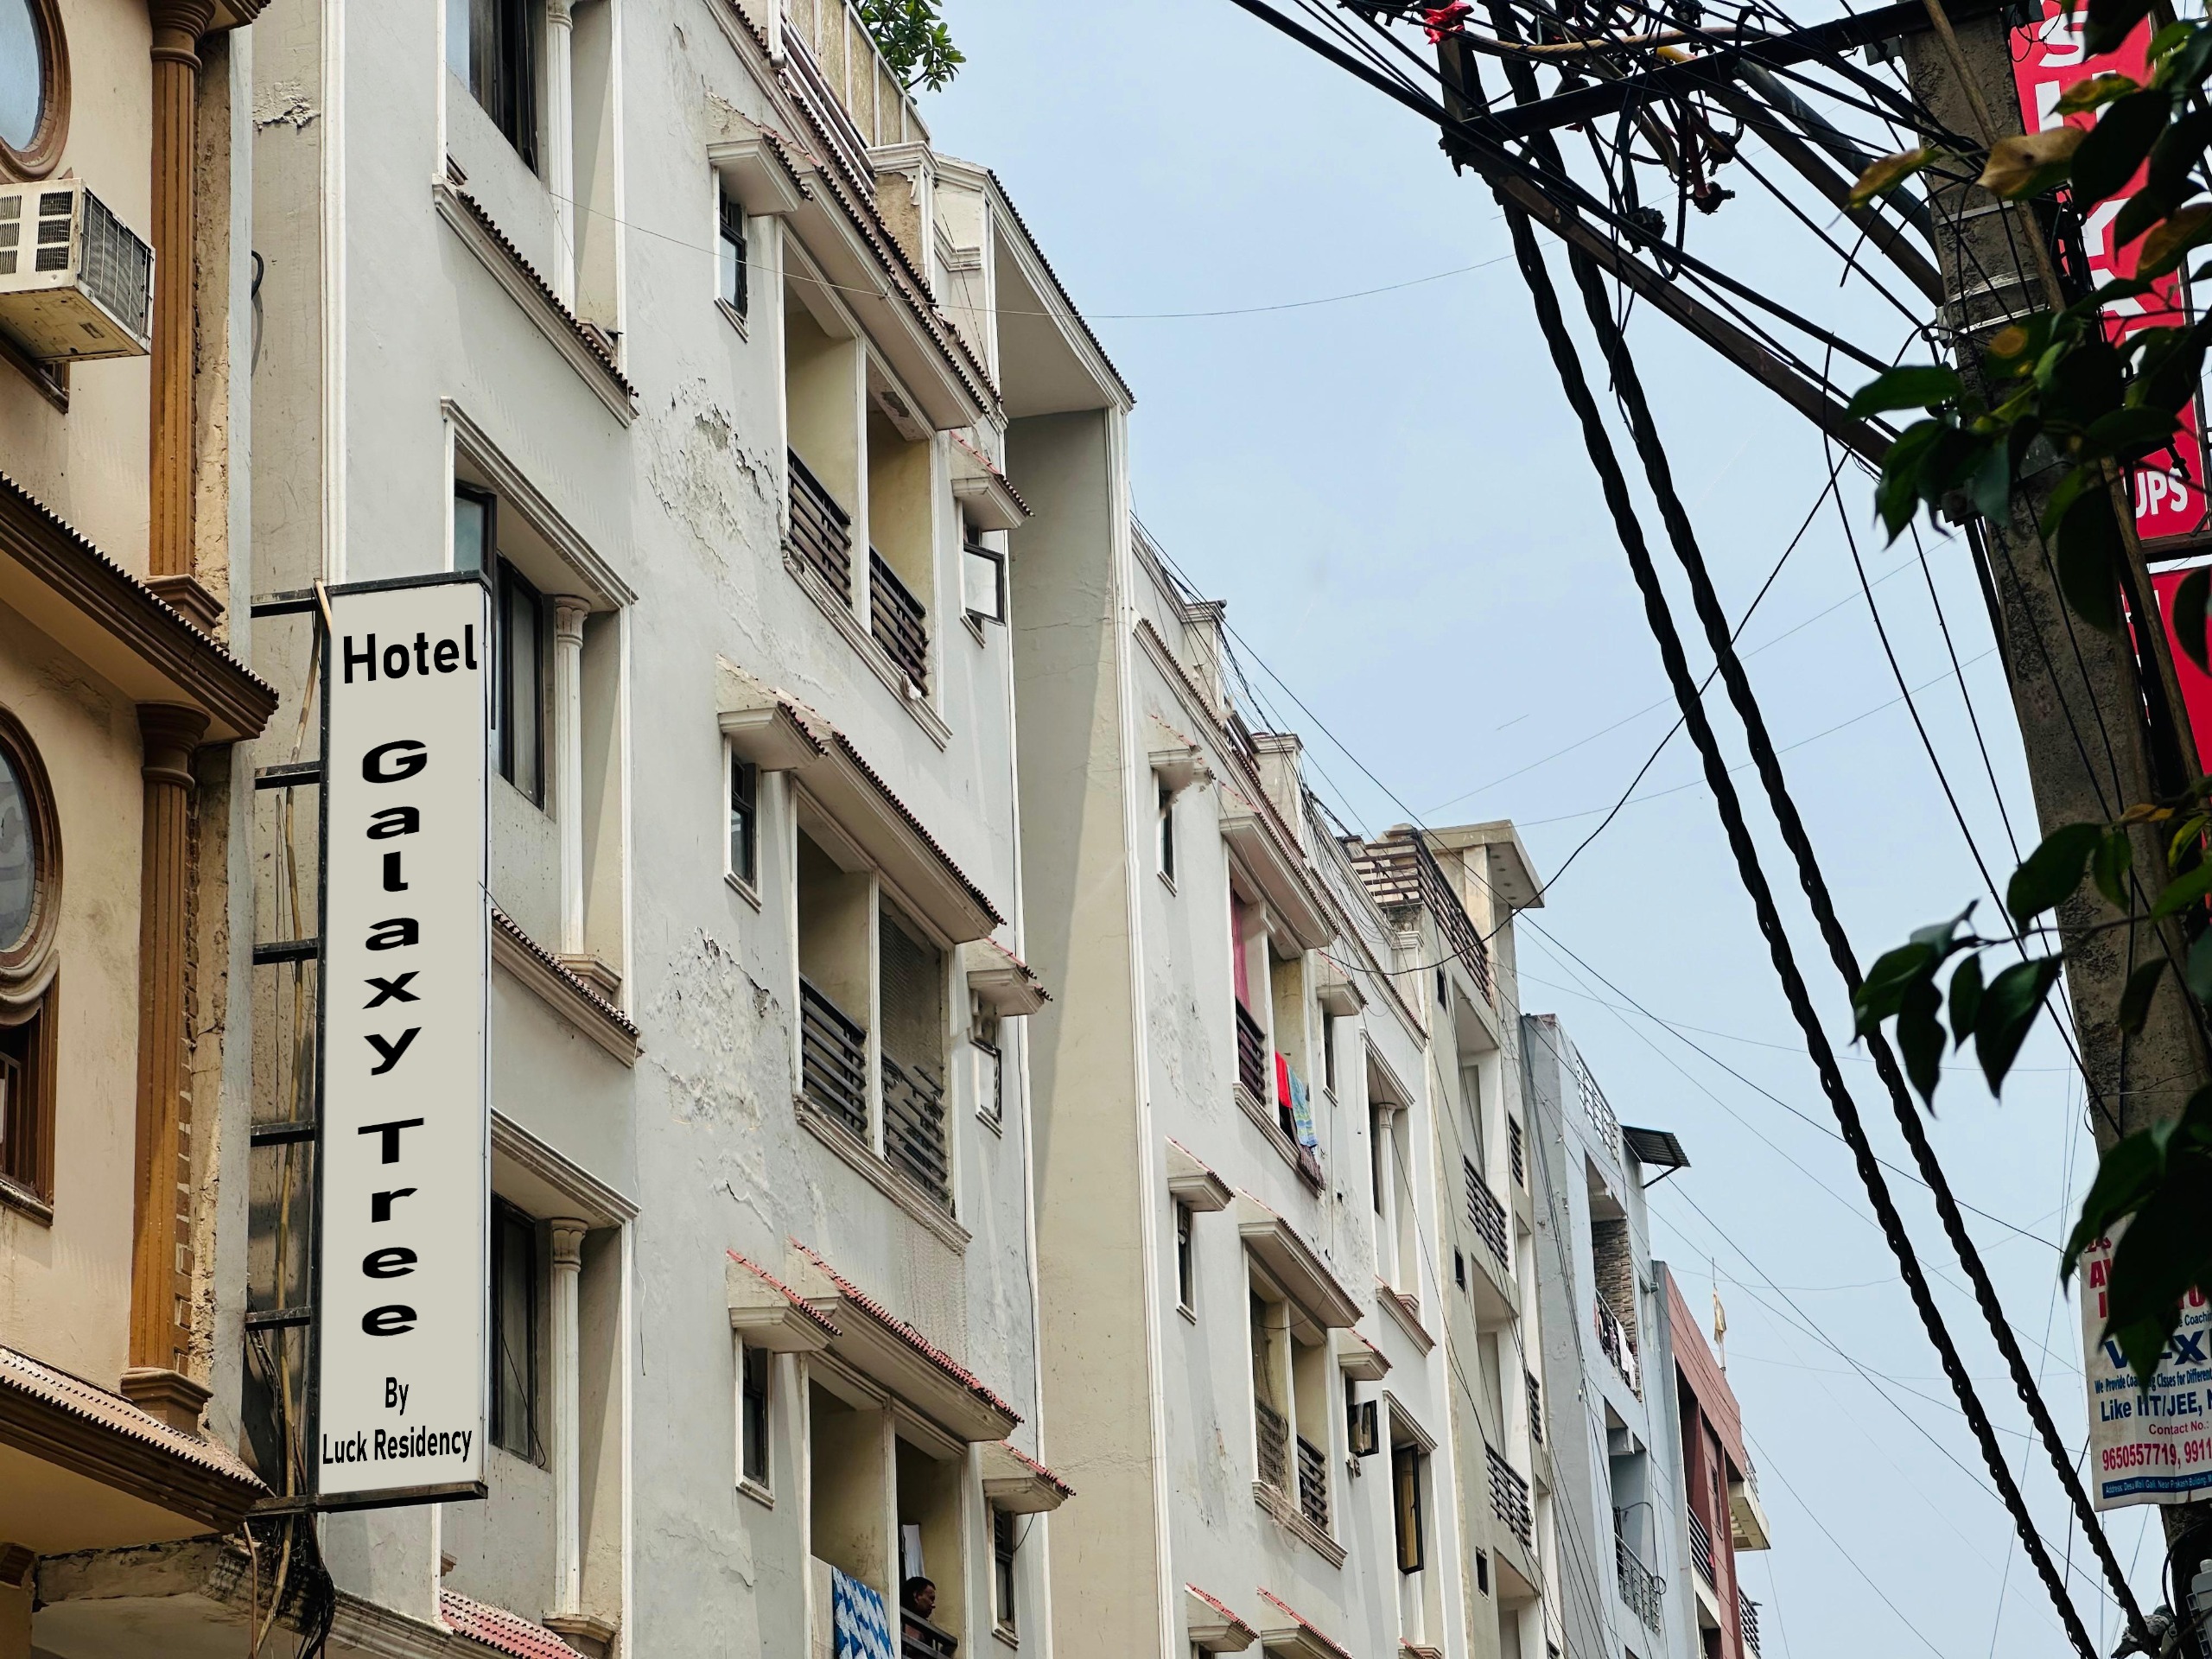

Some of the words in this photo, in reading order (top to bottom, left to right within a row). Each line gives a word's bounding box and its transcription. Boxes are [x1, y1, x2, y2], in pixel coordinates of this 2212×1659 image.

[343, 624, 478, 683] Hotel
[362, 740, 428, 1077] Galaxy
[358, 1117, 424, 1337] Tree
[385, 1377, 409, 1415] By
[2177, 1371, 2185, 1386] for
[2101, 1399, 2132, 1421] Like
[2149, 1423, 2189, 1435] Contact
[322, 1431, 367, 1465] Luck
[374, 1426, 473, 1463] Residency
